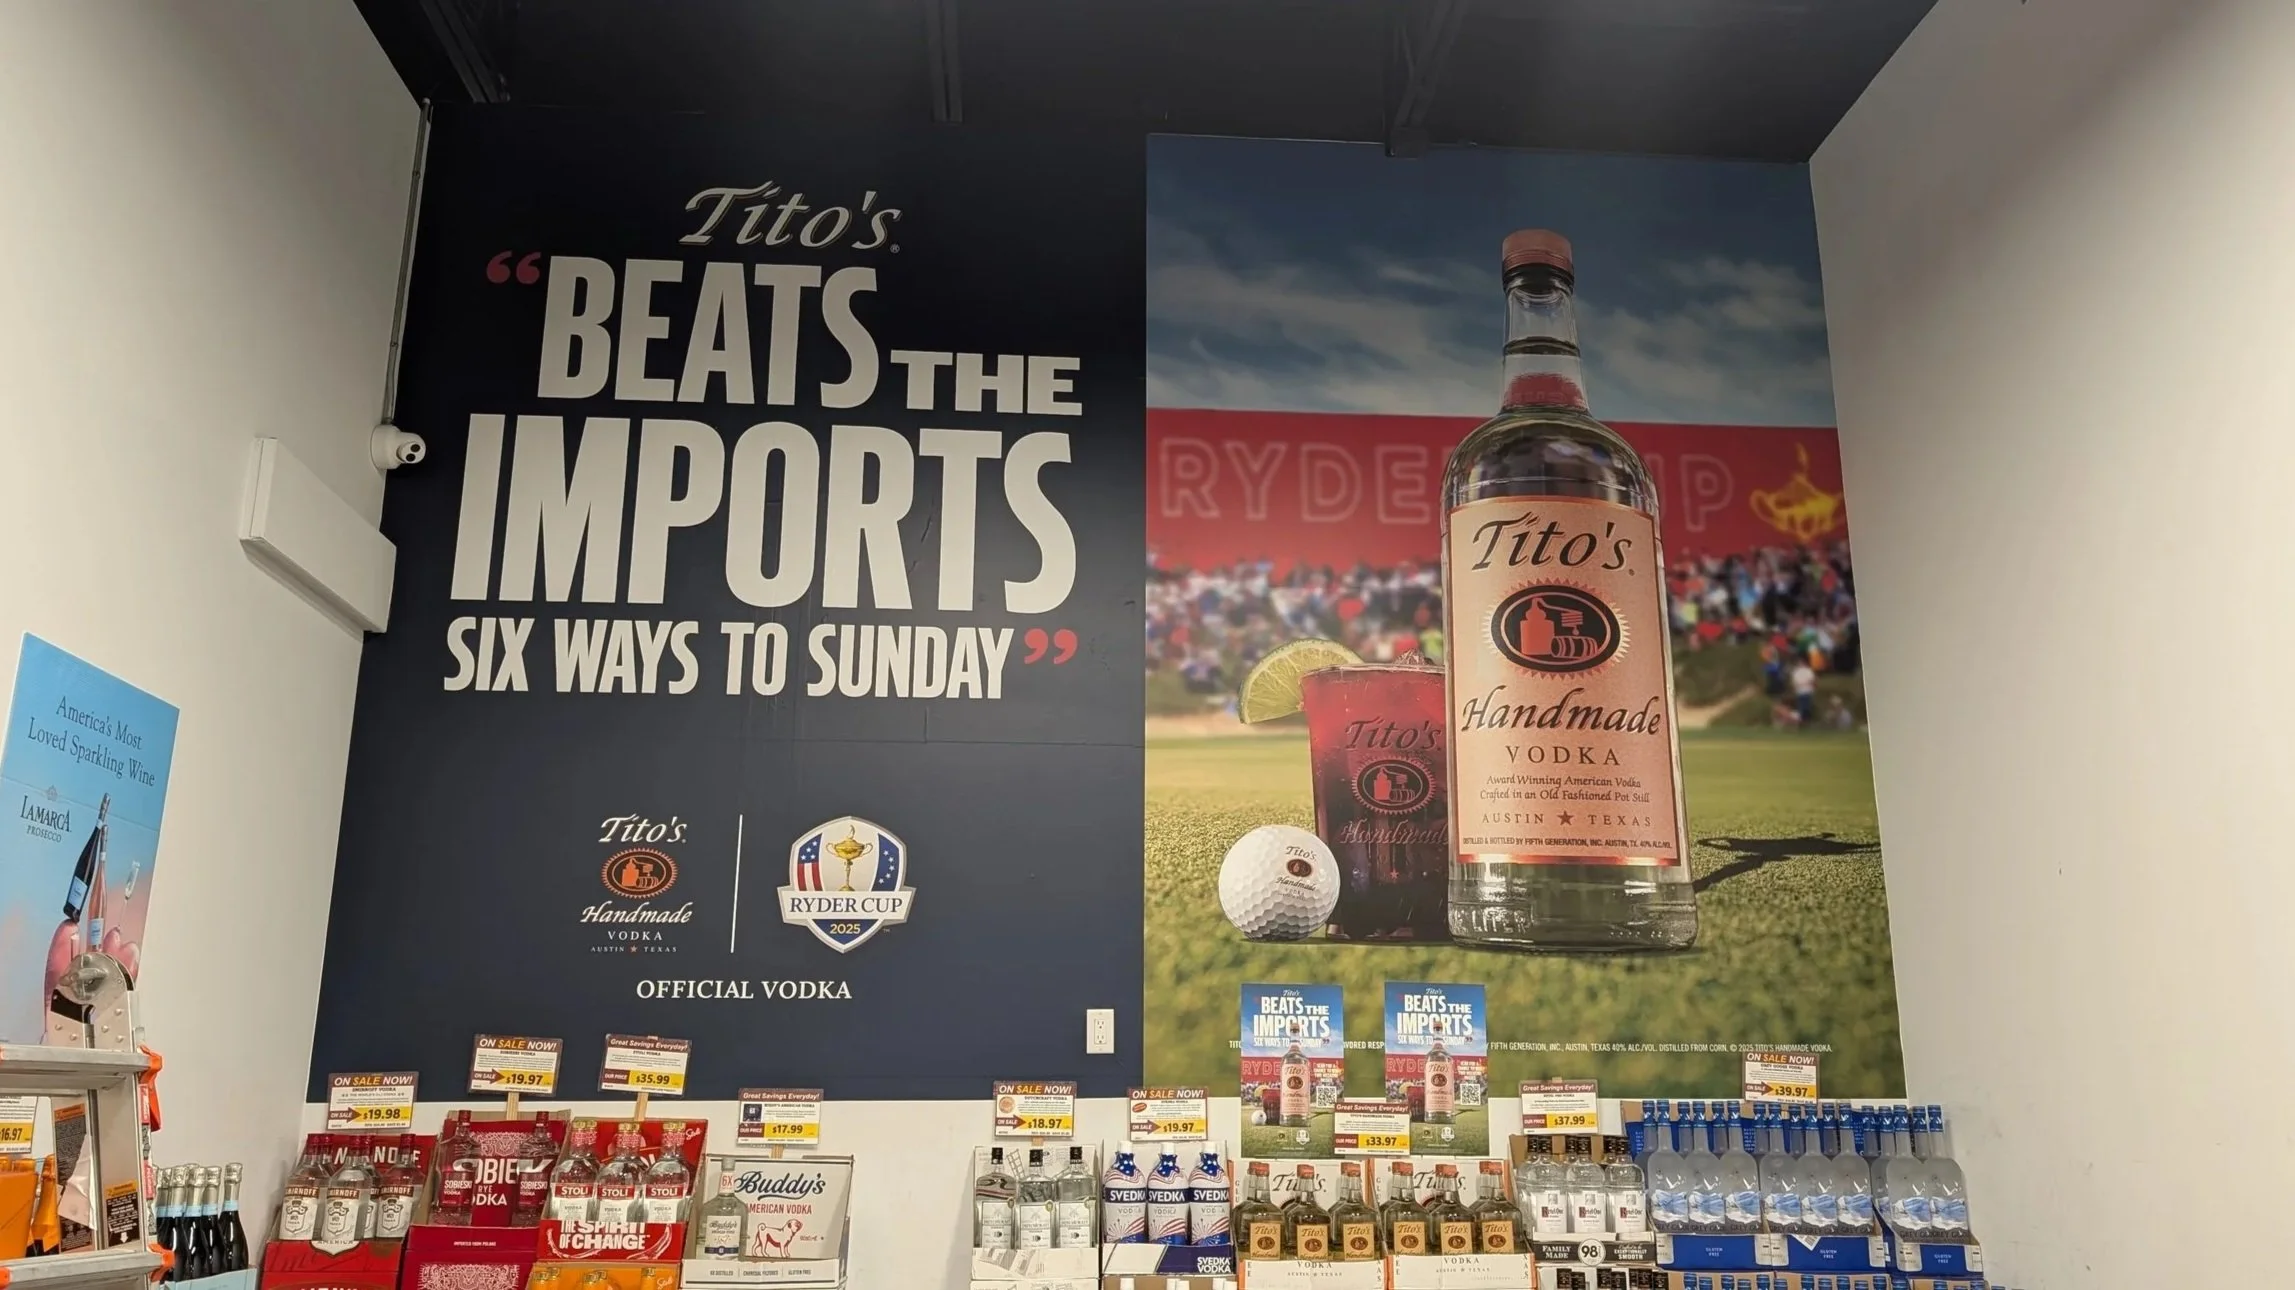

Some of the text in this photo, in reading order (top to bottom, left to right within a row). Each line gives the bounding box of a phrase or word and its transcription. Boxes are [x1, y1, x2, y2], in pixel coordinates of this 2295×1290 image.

[680, 181, 901, 252] Tito's
[891, 349, 1082, 415] THE
[1158, 437, 1432, 524] RYDE
[450, 413, 1076, 613] IMPORTS
[1471, 511, 1635, 576] Tito's
[443, 616, 535, 691] SIX
[554, 618, 699, 694] WAYS
[721, 622, 788, 696] TO
[1461, 684, 1661, 735] Handmade
[56, 695, 143, 750] America's Most
[1345, 716, 1441, 750] Tito's
[28, 716, 155, 787] Loved Sparkling Wine
[1505, 746, 1620, 766] VODKA
[1486, 775, 1642, 788] Award Winning American Vodka
[1480, 790, 1509, 804] Crafted
[1513, 790, 1521, 799] in
[1540, 788, 1558, 800] Old
[1562, 790, 1611, 801] Fashioned
[1614, 791, 1630, 802] Pot
[1482, 813, 1652, 826] AUSTIN TEXAS
[27, 825, 62, 843] PROSECCO
[598, 813, 687, 843] Tito's
[1463, 837, 1483, 845] DISTILLED
[1489, 837, 1515, 845] BOTTLED
[1525, 838, 1543, 846] FIFTH
[1285, 846, 1317, 861] Tito's
[790, 897, 904, 913] RYDER CUP
[580, 900, 693, 923] Handmade
[830, 923, 861, 935] 2025
[608, 931, 662, 940] VODKA
[636, 980, 853, 1000] OFFICIAL VODKA
[1261, 996, 1330, 1015] BEATS THE
[1404, 994, 1472, 1013] BEATS THE
[480, 1039, 556, 1051] ON SALE NOW!
[629, 1040, 654, 1048] Savings
[655, 1043, 688, 1051] Everyday!
[1490, 1042, 1508, 1050] FIFTH
[1590, 1043, 1611, 1051] TEXAS
[1611, 1043, 1626, 1051] 40%
[1659, 1043, 1689, 1051] DISTILLED
[1775, 1044, 1809, 1052] HANDMADE
[1763, 1054, 1787, 1063] SALE
[1789, 1056, 1814, 1064] NOW!
[334, 1075, 413, 1086] ON SALE NOW!
[506, 1073, 543, 1085] $19.97
[636, 1073, 670, 1085] $35.99
[999, 1085, 1072, 1094] ON SALE NOW!
[1132, 1089, 1204, 1099] ON SALE NOW!
[1775, 1086, 1808, 1097] $39.97
[363, 1108, 400, 1120] $19.98
[1028, 1118, 1062, 1129] $18.97
[1554, 1116, 1585, 1125] $37.99
[772, 1124, 803, 1134] $17.99
[1163, 1122, 1194, 1133] $19.97
[1366, 1136, 1397, 1146] $33.97
[444, 1181, 472, 1189] SOBIESKI
[520, 1181, 547, 1189] SOBIESKI
[721, 1175, 733, 1186] 6X
[734, 1170, 826, 1201] Buddy's
[478, 1185, 493, 1193] RYE
[561, 1187, 588, 1195] STOLI
[602, 1188, 628, 1197] STOLI
[651, 1187, 678, 1196] STOLI
[1193, 1189, 1229, 1201] SVEDKA
[1110, 1190, 1146, 1201] SVEDKA
[1148, 1190, 1185, 1202] SVEDKA
[745, 1203, 812, 1214] AMERICAN VODKA
[561, 1220, 646, 1234] THE SPIRIT
[1255, 1225, 1277, 1235] Tito's
[1301, 1227, 1325, 1237] Tito's
[1347, 1225, 1370, 1236] Tito's
[1398, 1223, 1421, 1234] Tito's
[1444, 1224, 1468, 1234] Tito's
[1485, 1223, 1508, 1233] Tito's
[559, 1234, 646, 1250] OF CHANGE
[1581, 1245, 1598, 1257] 98
[1197, 1257, 1231, 1265] SVEDKA
[1197, 1265, 1231, 1273] VODKA
